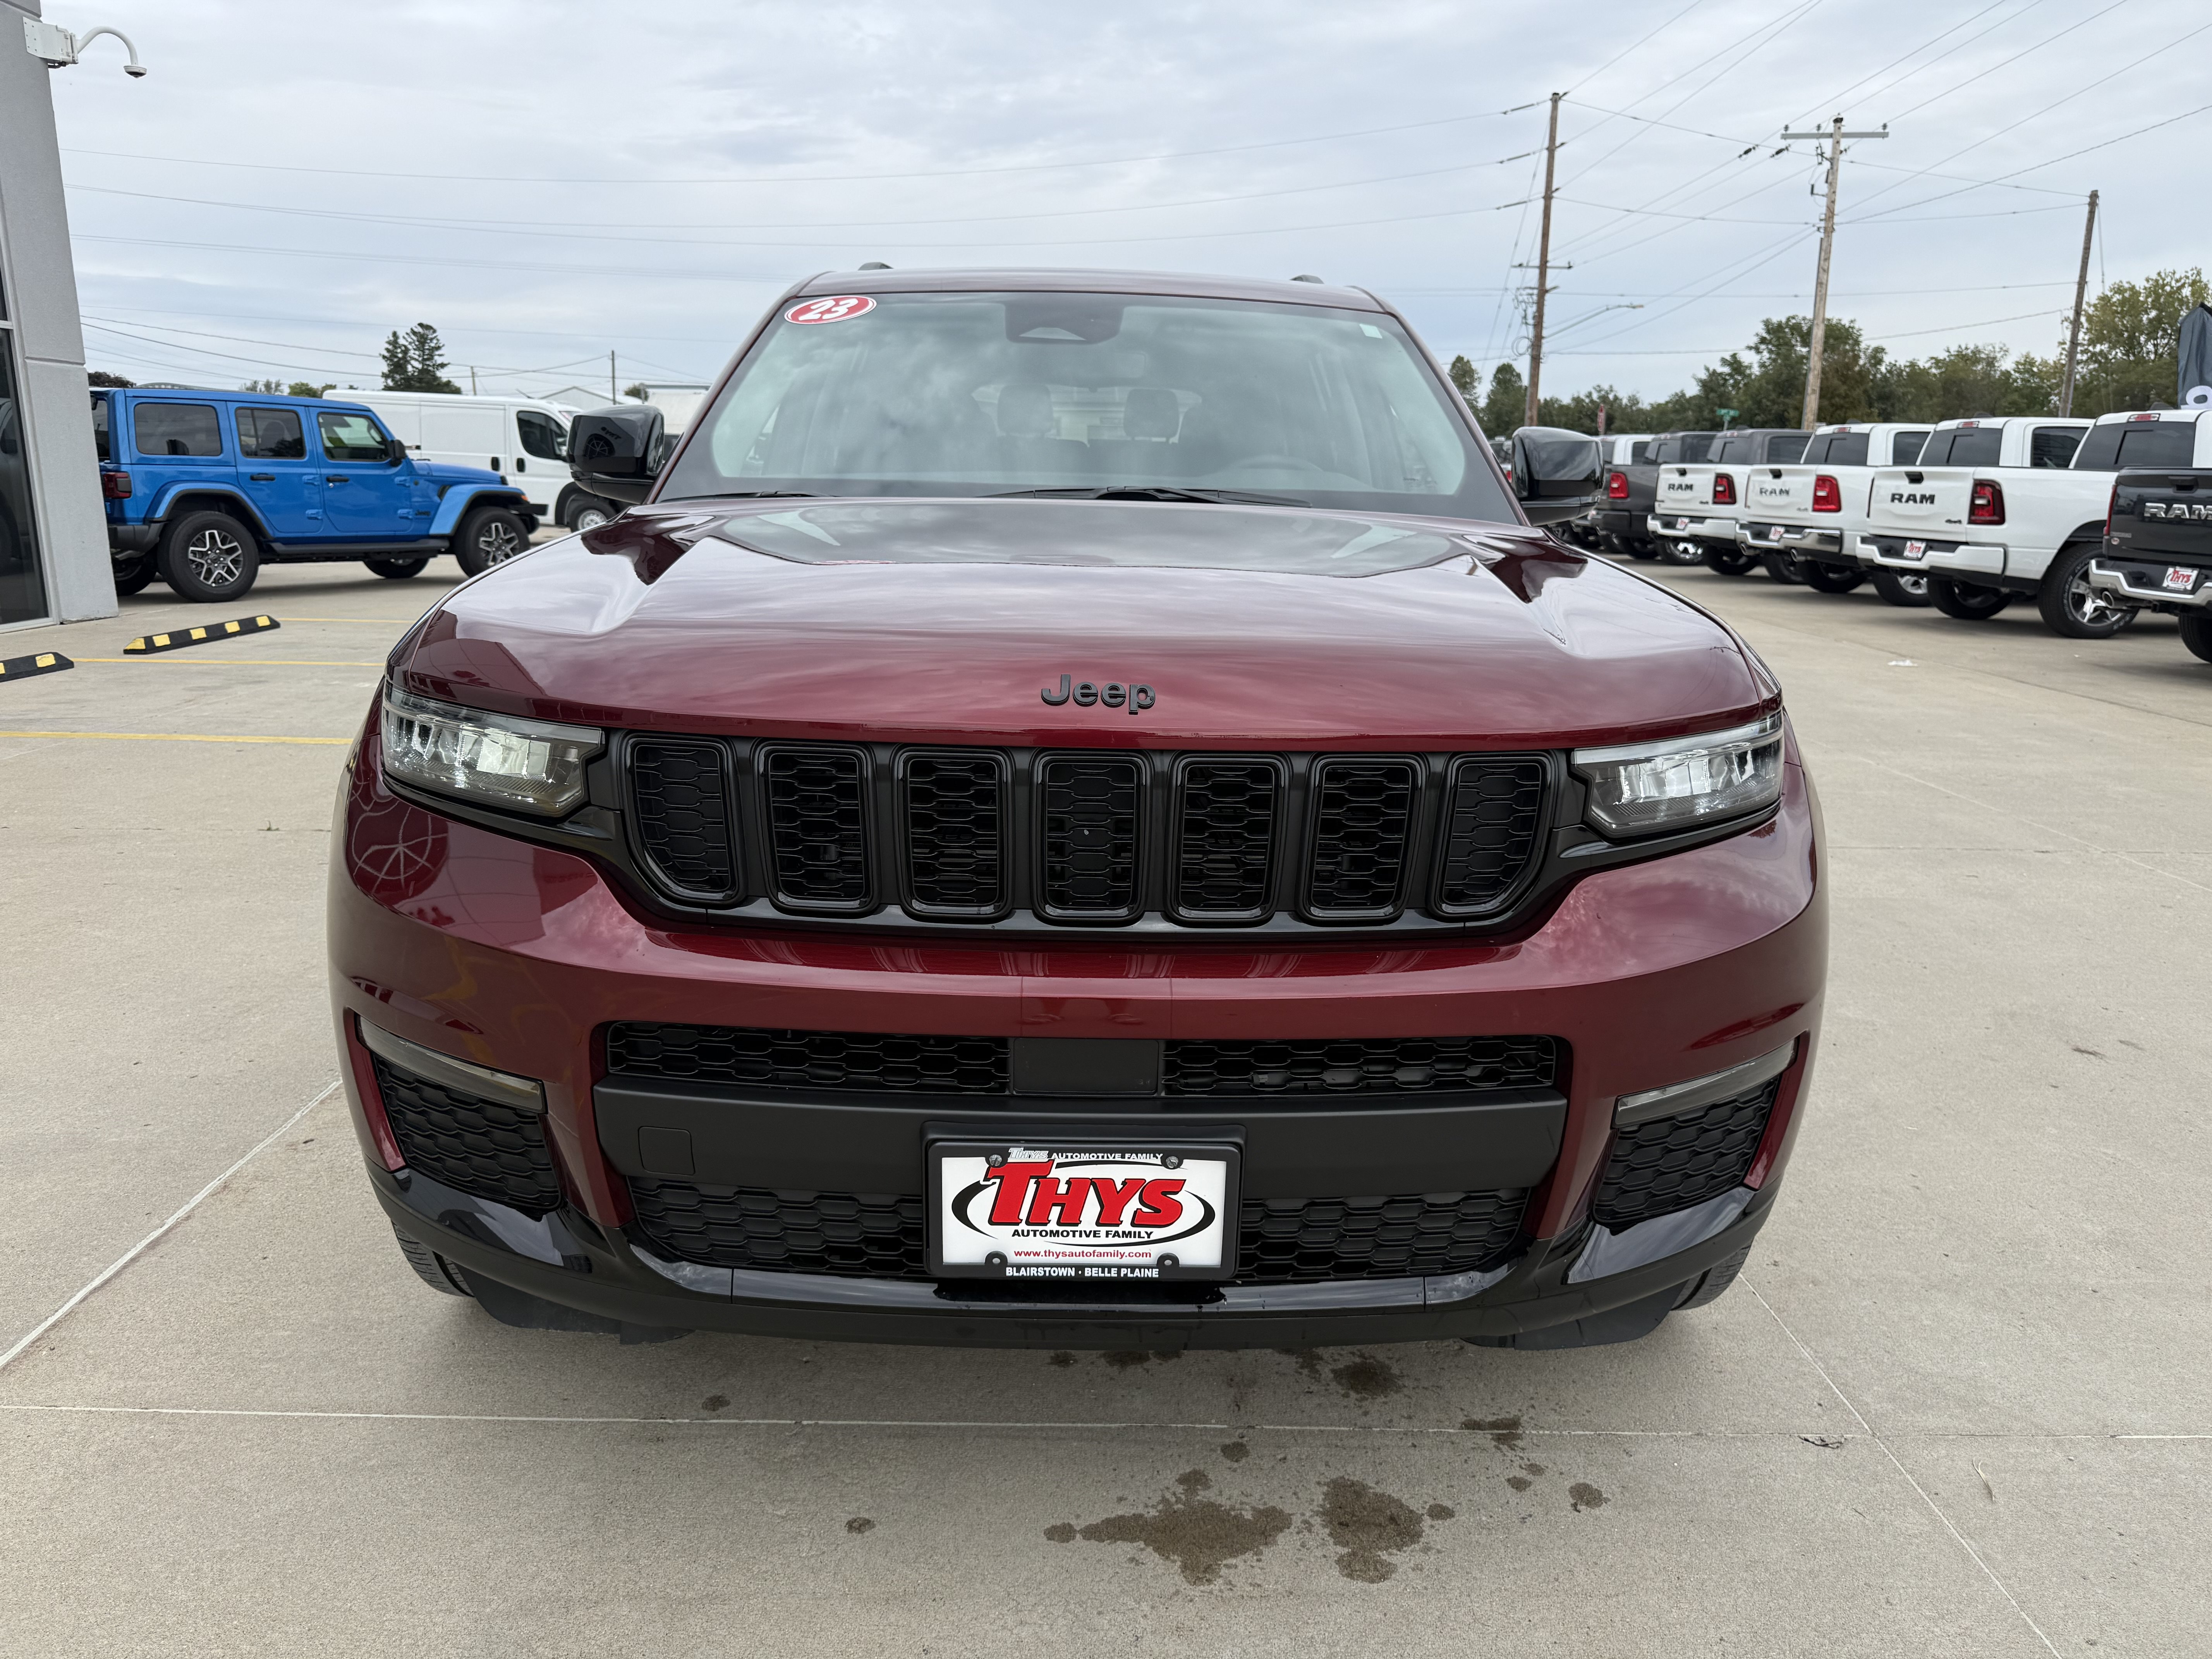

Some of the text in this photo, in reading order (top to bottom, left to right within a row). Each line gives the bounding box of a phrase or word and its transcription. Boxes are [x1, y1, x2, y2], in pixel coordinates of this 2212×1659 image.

[798, 298, 859, 321] 23
[1668, 483, 1693, 491] RAM
[1759, 487, 1790, 496] RAM
[1890, 493, 1935, 505] RAM
[2144, 502, 2212, 520] RAM
[1041, 674, 1156, 715] Jeep
[983, 1159, 1186, 1228] THYS
[1012, 1229, 1154, 1239] AUTOMOTIVE FAMILY
[1014, 1249, 1152, 1259] www.thysautofamily.com
[1006, 1267, 1159, 1278] BLAIRSTOWN BELLE PLAINE
